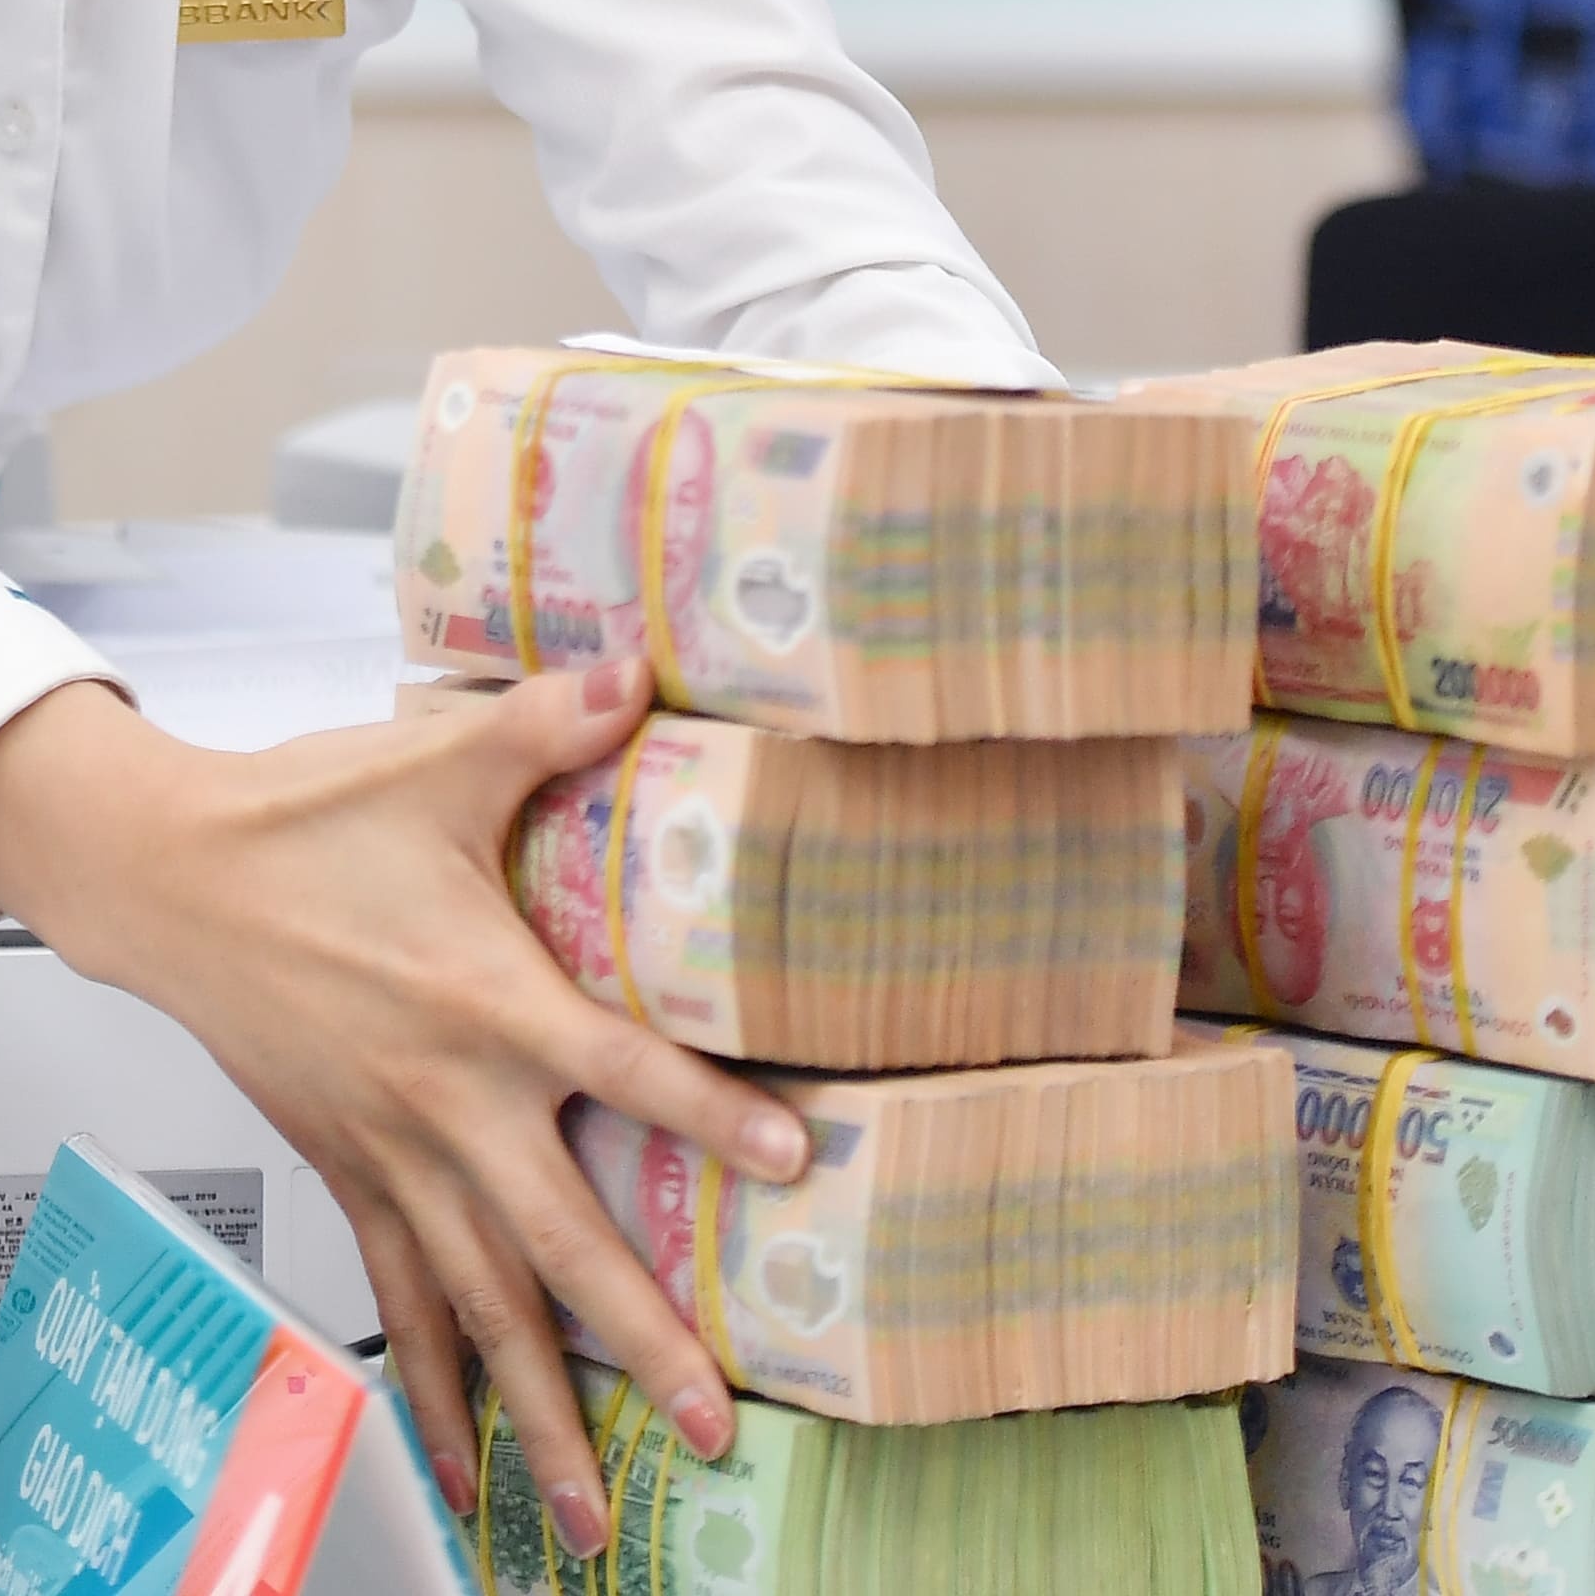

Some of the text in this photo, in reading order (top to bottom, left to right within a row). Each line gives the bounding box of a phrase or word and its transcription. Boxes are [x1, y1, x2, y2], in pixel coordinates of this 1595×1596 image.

[1361, 763, 1511, 834] 2000
[1296, 1085, 1455, 1166] 50000
[20, 1423, 84, 1531] GIAO
